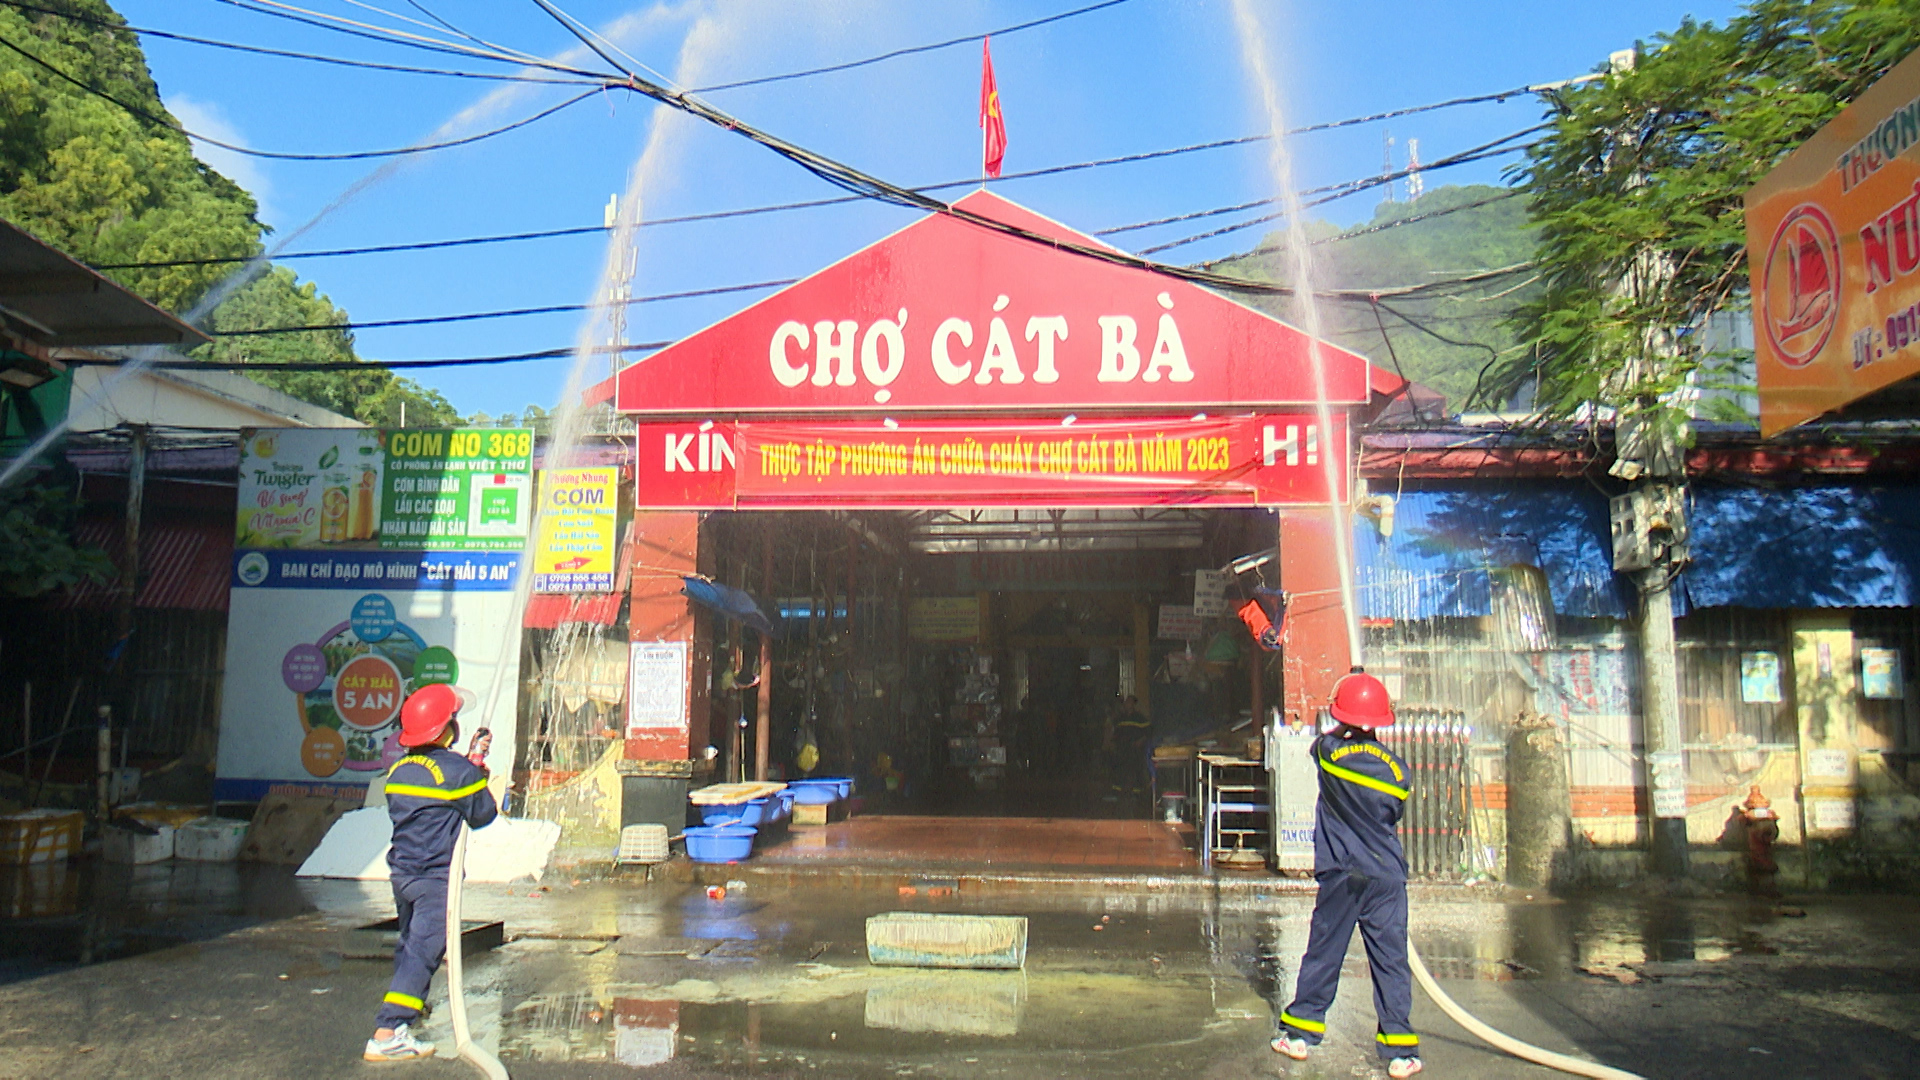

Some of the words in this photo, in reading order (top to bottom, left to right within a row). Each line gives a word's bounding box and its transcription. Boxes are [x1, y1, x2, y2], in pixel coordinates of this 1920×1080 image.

[769, 307, 908, 404] CHỢ
[931, 294, 1069, 385] CÁT
[1097, 291, 1195, 382] BÀ
[391, 431, 443, 457] CƠM
[450, 433, 481, 457] NO
[488, 433, 530, 457] 368
[760, 441, 801, 483] THỰC
[806, 437, 836, 483] TẬP
[840, 441, 907, 476] PHƯƠNG
[912, 436, 936, 475] ÁN
[940, 436, 985, 475] CHỮA
[989, 435, 1033, 474] CHÁY
[1039, 437, 1072, 480] CHỢ
[1077, 433, 1109, 473] CÁT
[1113, 433, 1137, 472] BÀ
[1142, 432, 1182, 472] NĂM
[1187, 437, 1230, 471] 2023
[394, 476, 415, 493] CƠM
[417, 475, 439, 492] BÌNH
[440, 475, 460, 492] DÂN
[581, 472, 608, 484] Nhung
[415, 496, 433, 513] CÁC
[434, 499, 456, 517] LOẠI
[553, 488, 604, 505] CƠM
[303, 507, 315, 526] C
[382, 517, 407, 538] NHẬN
[429, 517, 446, 535] HẢI
[447, 517, 466, 535] SẢN
[281, 563, 308, 578] BAN
[310, 559, 332, 578] CHỈ
[334, 563, 360, 581] ĐẠO
[363, 562, 384, 578] MÔ
[386, 562, 418, 578] HÌNH
[453, 560, 476, 580] HẢI
[478, 564, 488, 580] 5
[343, 674, 367, 688] CÁT
[370, 674, 394, 688] HẢI
[343, 691, 357, 709] 5
[361, 691, 393, 710] AN
